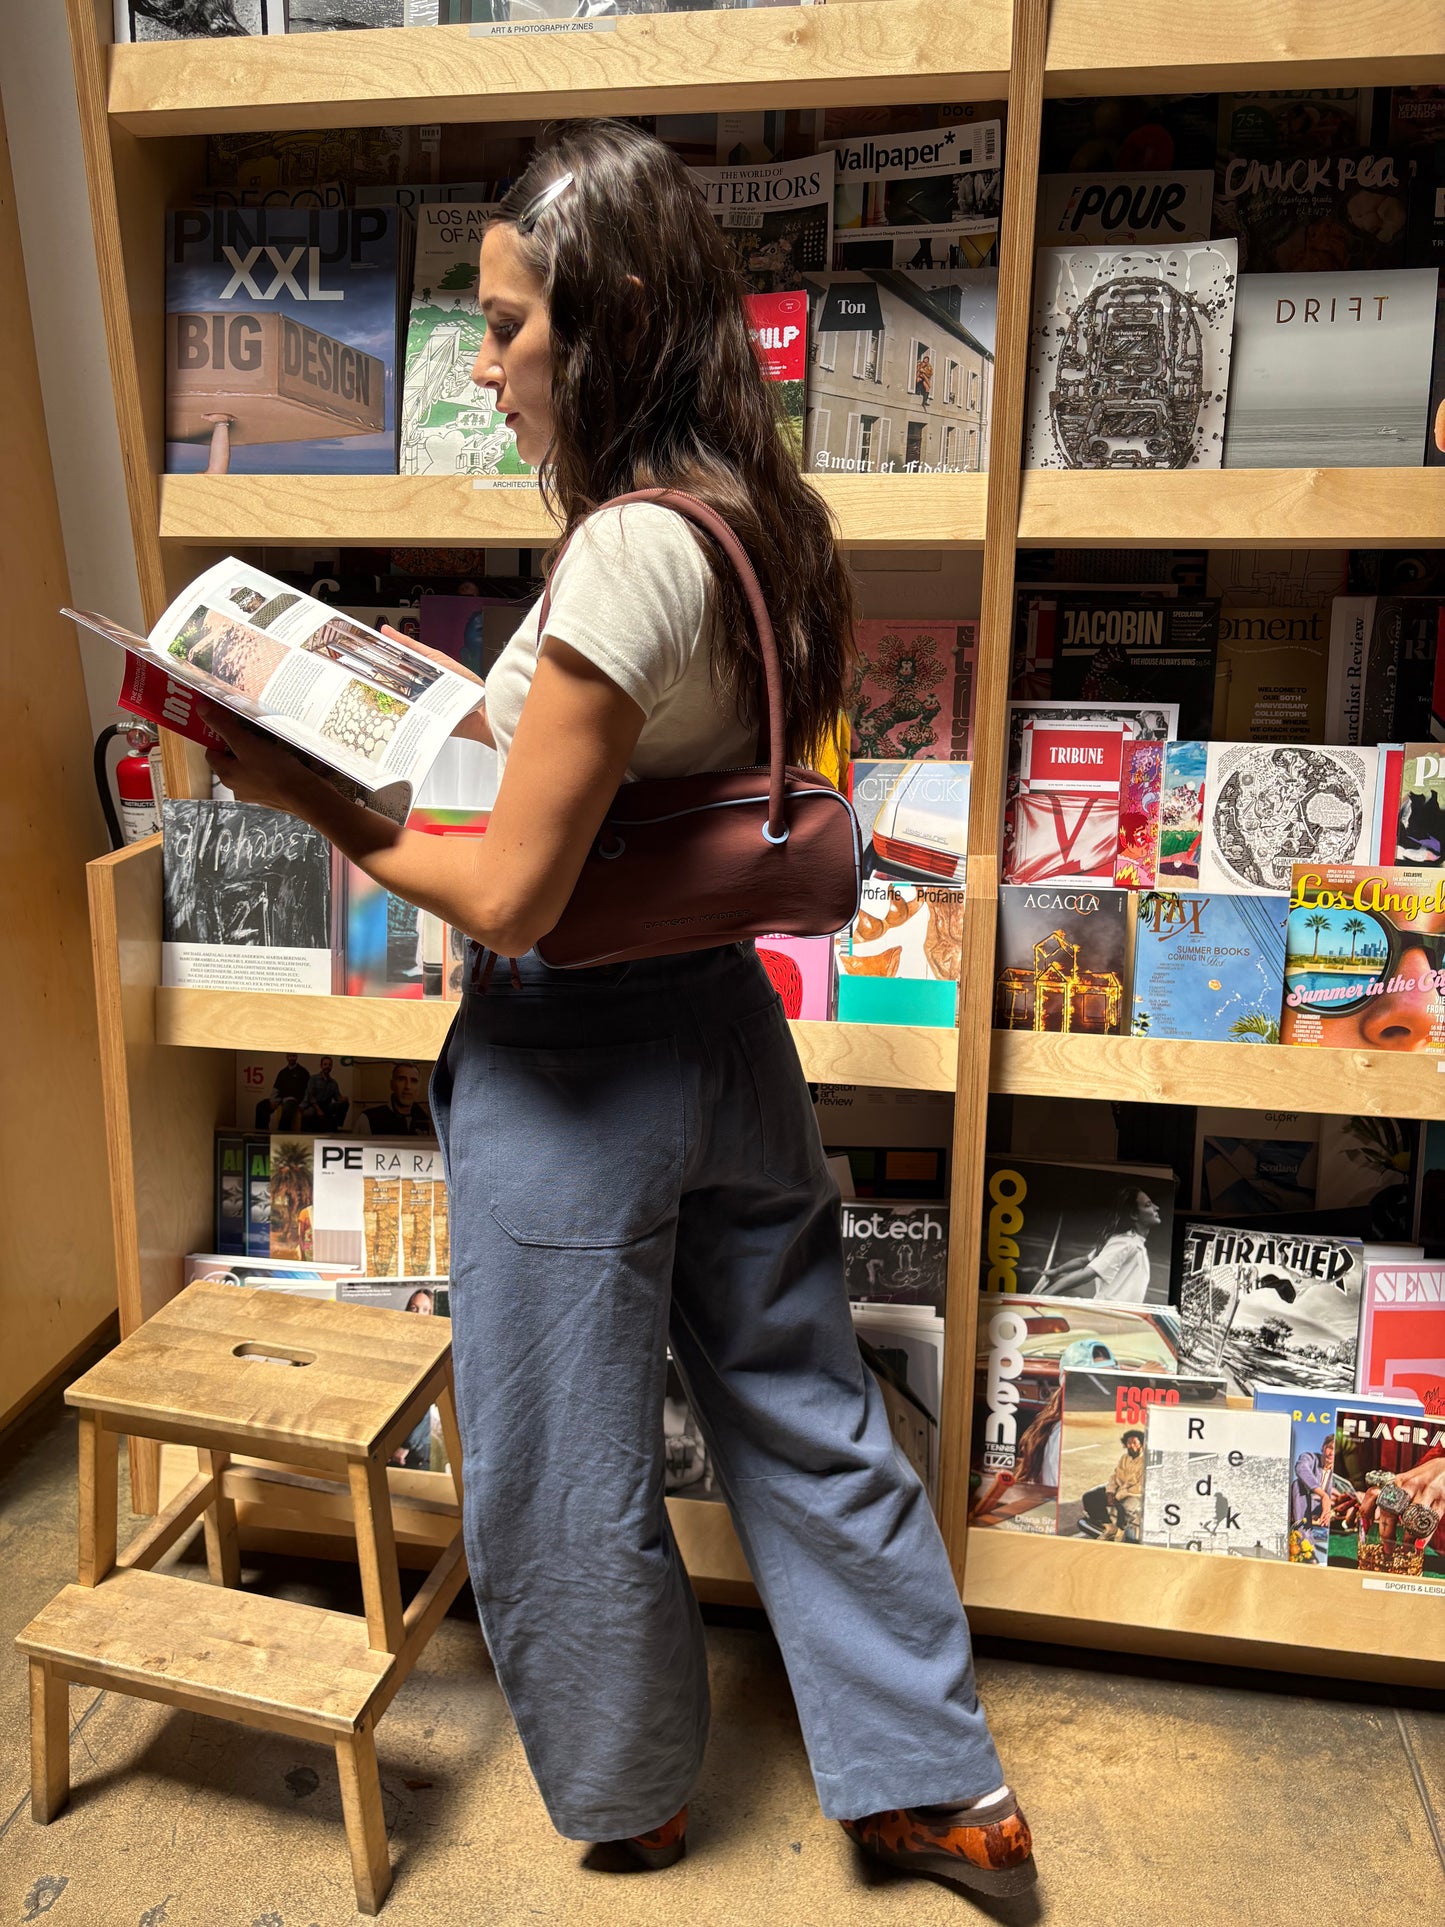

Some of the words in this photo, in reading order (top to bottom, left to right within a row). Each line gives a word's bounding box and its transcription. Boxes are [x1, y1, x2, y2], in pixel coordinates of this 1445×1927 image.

[514, 24, 570, 33] PHOTOGRAPHY
[571, 23, 594, 31] ZINES
[942, 105, 974, 117] DOG
[720, 171, 739, 179] THE
[740, 169, 773, 179] WORLD
[774, 168, 783, 176] OF
[1071, 183, 1185, 232] POUR
[427, 209, 462, 225] LOS
[441, 228, 465, 243] OF
[218, 245, 345, 301] XXL
[837, 299, 867, 314] Ton
[1276, 296, 1389, 324] DRIFT
[177, 314, 262, 372] BIG
[284, 321, 370, 407] DESIGN
[815, 451, 875, 473] Amour
[880, 460, 895, 474] et
[1062, 610, 1165, 646] JACOBIN
[1347, 616, 1365, 678] Review
[1130, 658, 1140, 666] THE
[1141, 658, 1159, 666] HOUSE
[1160, 658, 1181, 666] ALWAYS
[1181, 658, 1196, 666] WINS
[1257, 686, 1295, 694] WELCOME
[1296, 686, 1307, 695] TO
[1263, 694, 1279, 702] OUR
[1249, 726, 1263, 734] WE
[1289, 727, 1310, 735] OPEN
[1049, 747, 1104, 766] TRIBUNE
[862, 887, 901, 902] rofane
[916, 888, 965, 904] Profane
[1289, 873, 1355, 910] Los
[1024, 894, 1099, 911] ACACIA
[1167, 953, 1198, 962] COMING
[1198, 954, 1207, 962] IN
[1177, 945, 1212, 955] SUMMER
[1214, 947, 1250, 957] BOOKS
[1286, 983, 1363, 1007] Summer
[1365, 977, 1384, 996] in
[1386, 974, 1415, 994] the
[243, 1066, 265, 1085] 15
[820, 1090, 835, 1099] art
[820, 1096, 854, 1107] review
[322, 1146, 363, 1170] PE
[1259, 1162, 1298, 1175] Scotland
[1188, 1228, 1355, 1296] THRASHER
[1374, 1271, 1445, 1303] SEN
[986, 1443, 1016, 1454] TENNIS
[1385, 1582, 1416, 1592] SPORTS
